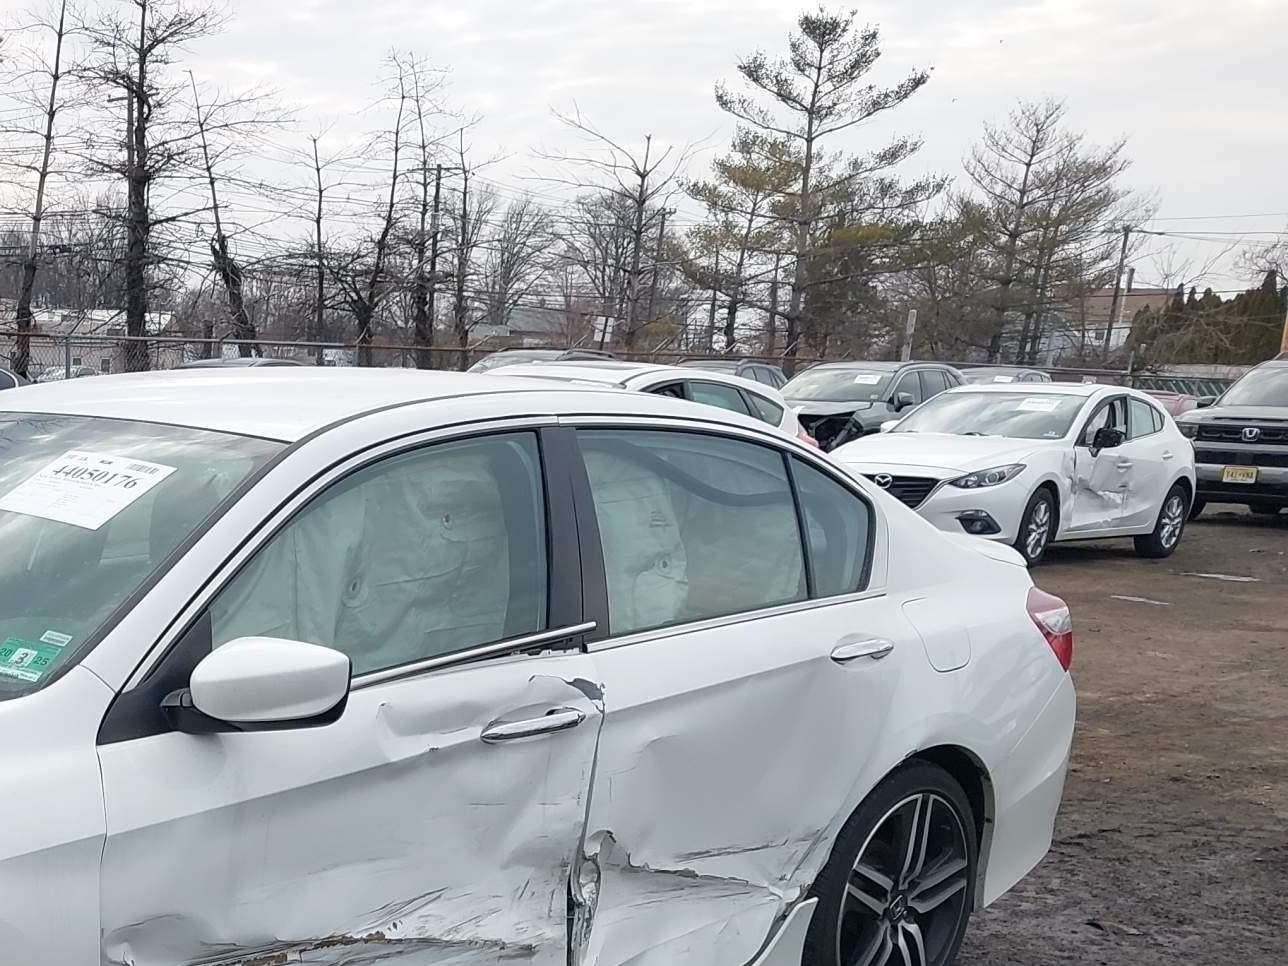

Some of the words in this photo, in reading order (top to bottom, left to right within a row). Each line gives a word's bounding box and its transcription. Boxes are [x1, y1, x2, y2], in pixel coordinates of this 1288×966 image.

[52, 464, 142, 489] 44050176
[15, 653, 28, 665] 3
[33, 656, 49, 666] 25
